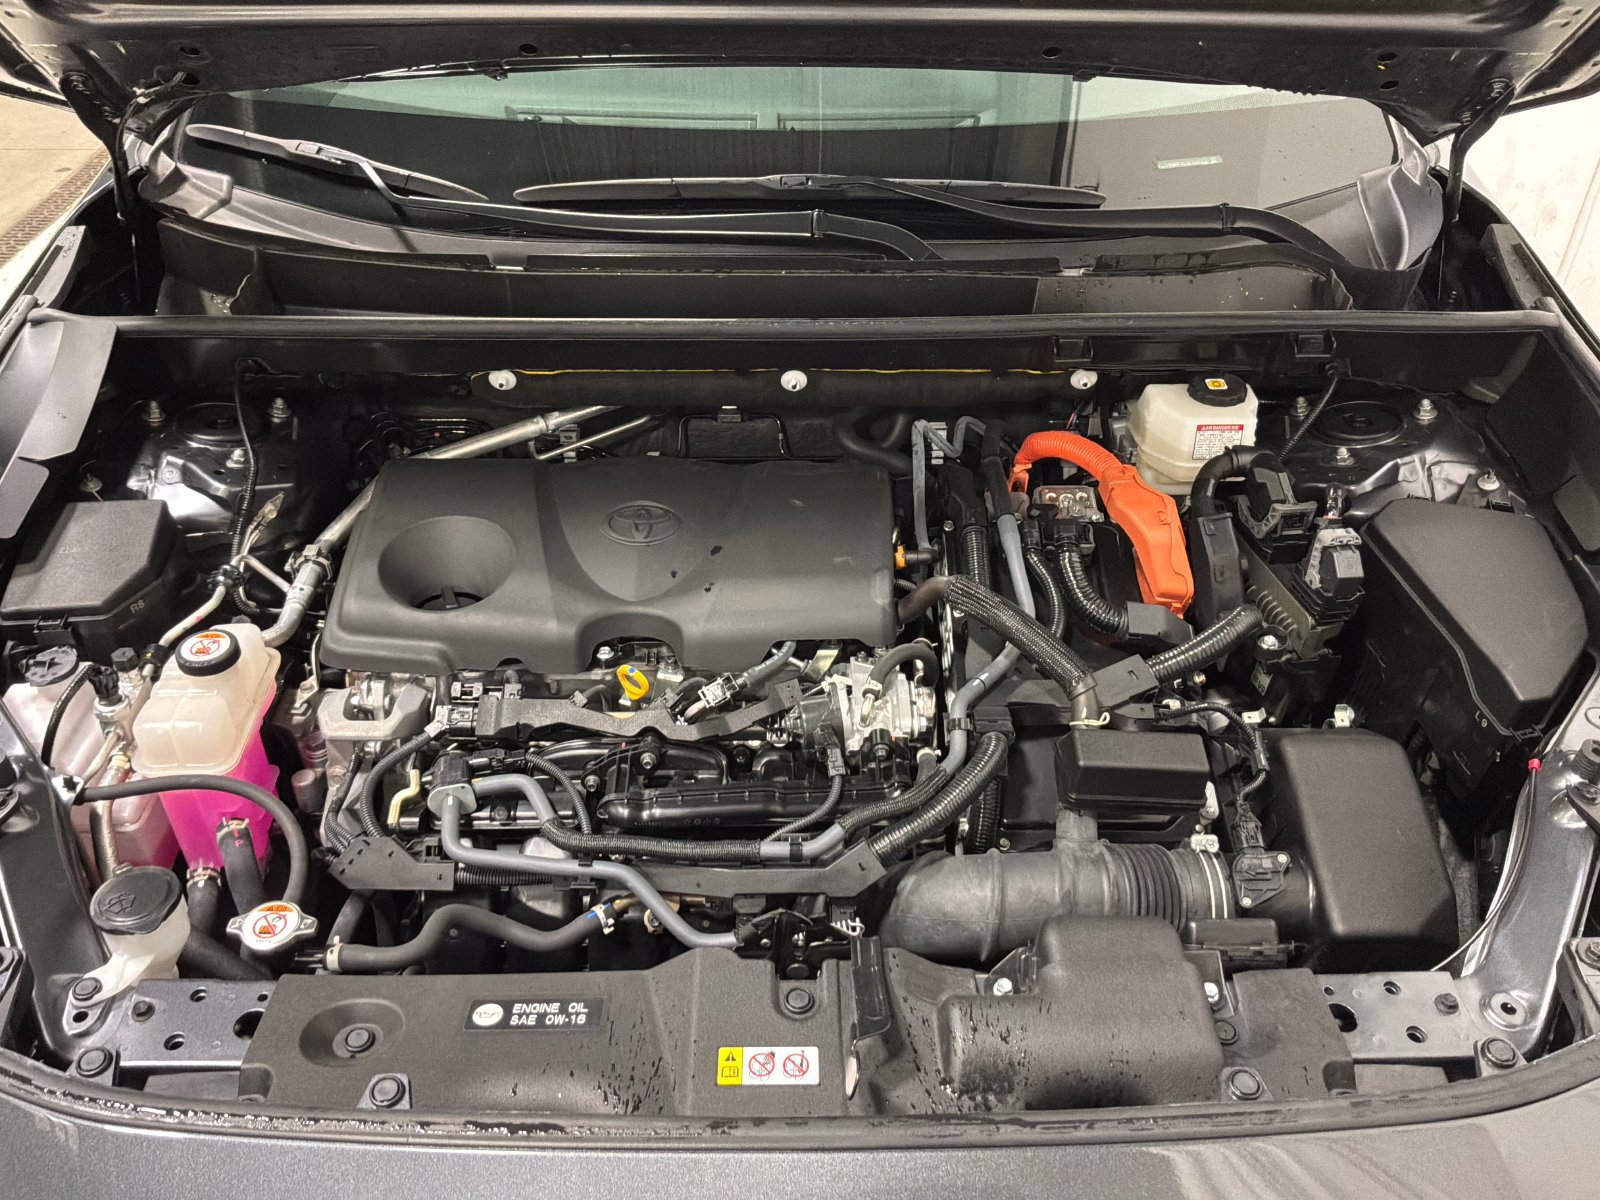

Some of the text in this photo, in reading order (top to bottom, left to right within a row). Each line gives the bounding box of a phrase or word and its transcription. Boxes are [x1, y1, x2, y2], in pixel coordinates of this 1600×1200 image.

[512, 1002, 589, 1014] ENGINE OIL
[509, 1014, 587, 1026] SAE 0W-16
